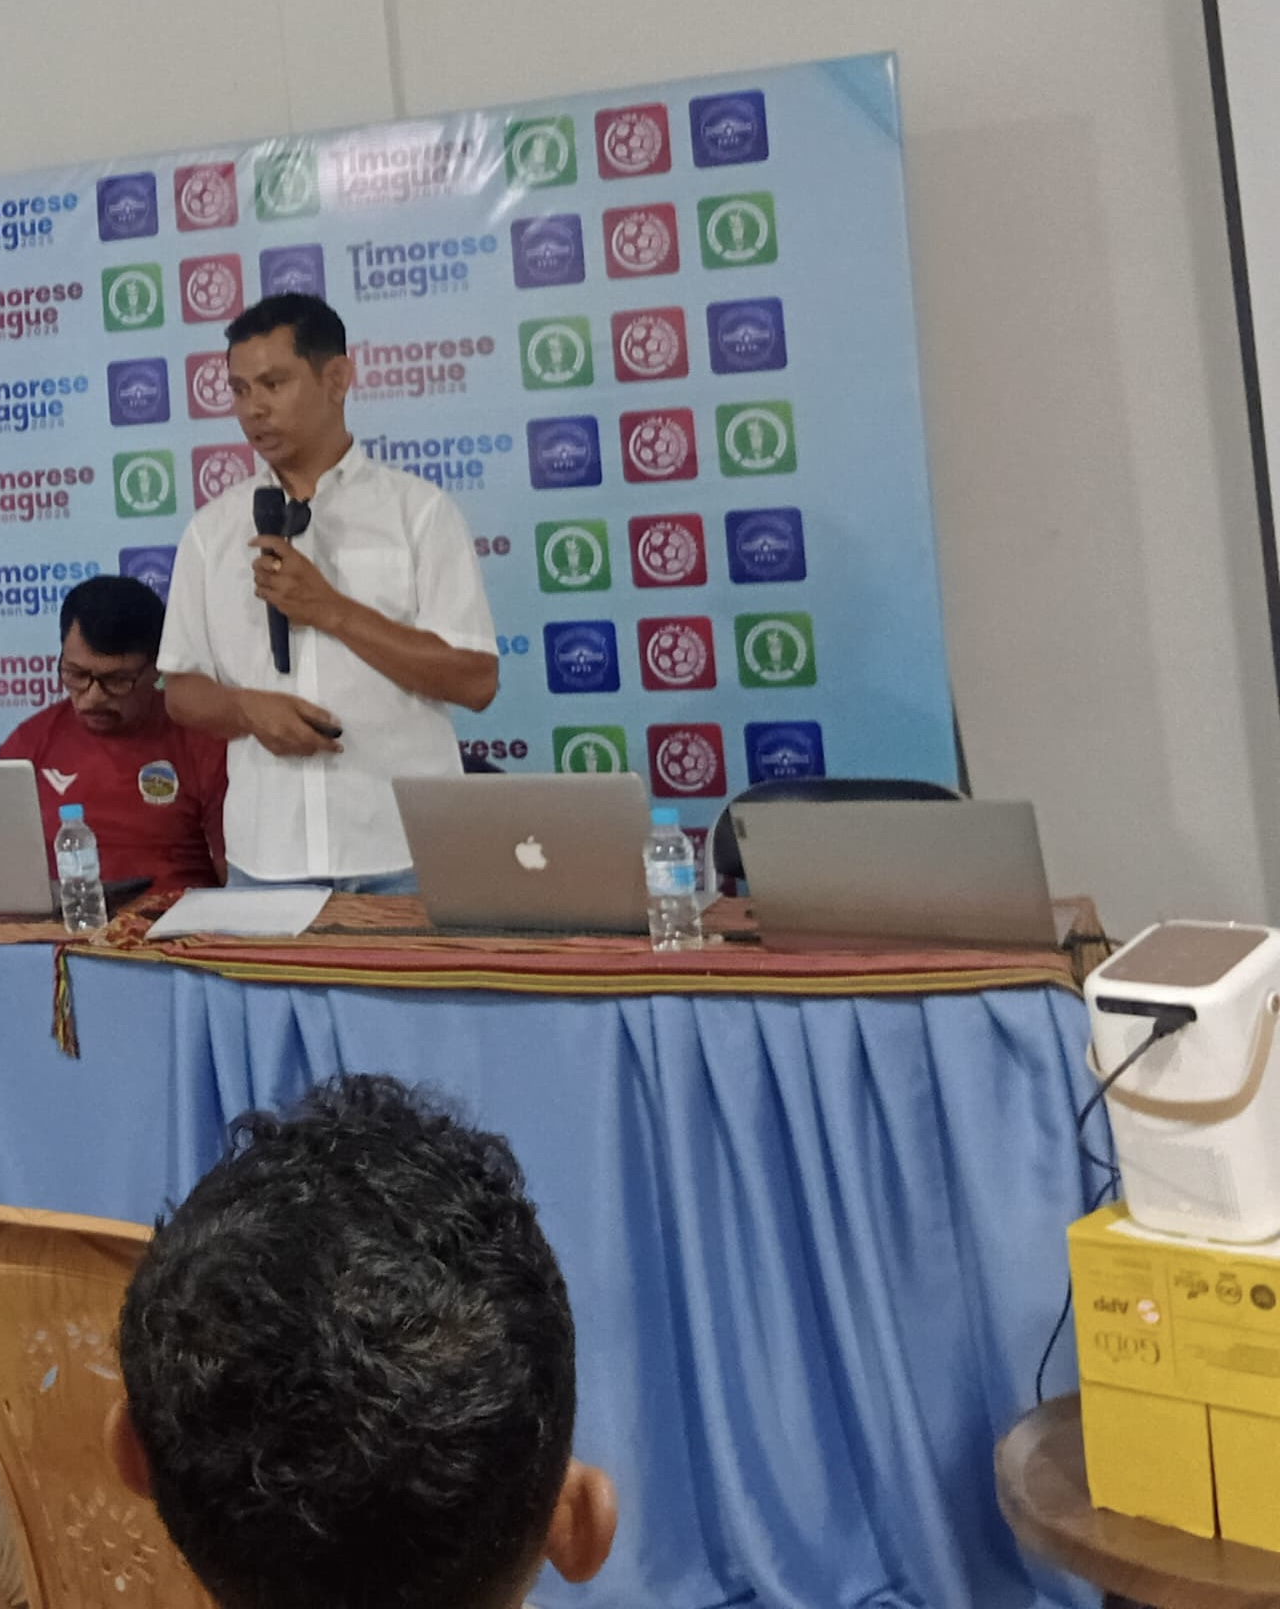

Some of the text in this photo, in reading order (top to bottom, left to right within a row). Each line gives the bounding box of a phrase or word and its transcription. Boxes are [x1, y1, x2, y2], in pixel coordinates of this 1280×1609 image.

[346, 234, 498, 266] Timorese
[354, 260, 469, 298] League
[346, 335, 496, 367] Timorese
[352, 362, 466, 398] League
[360, 432, 514, 462] Timorese
[458, 738, 529, 761] rese
